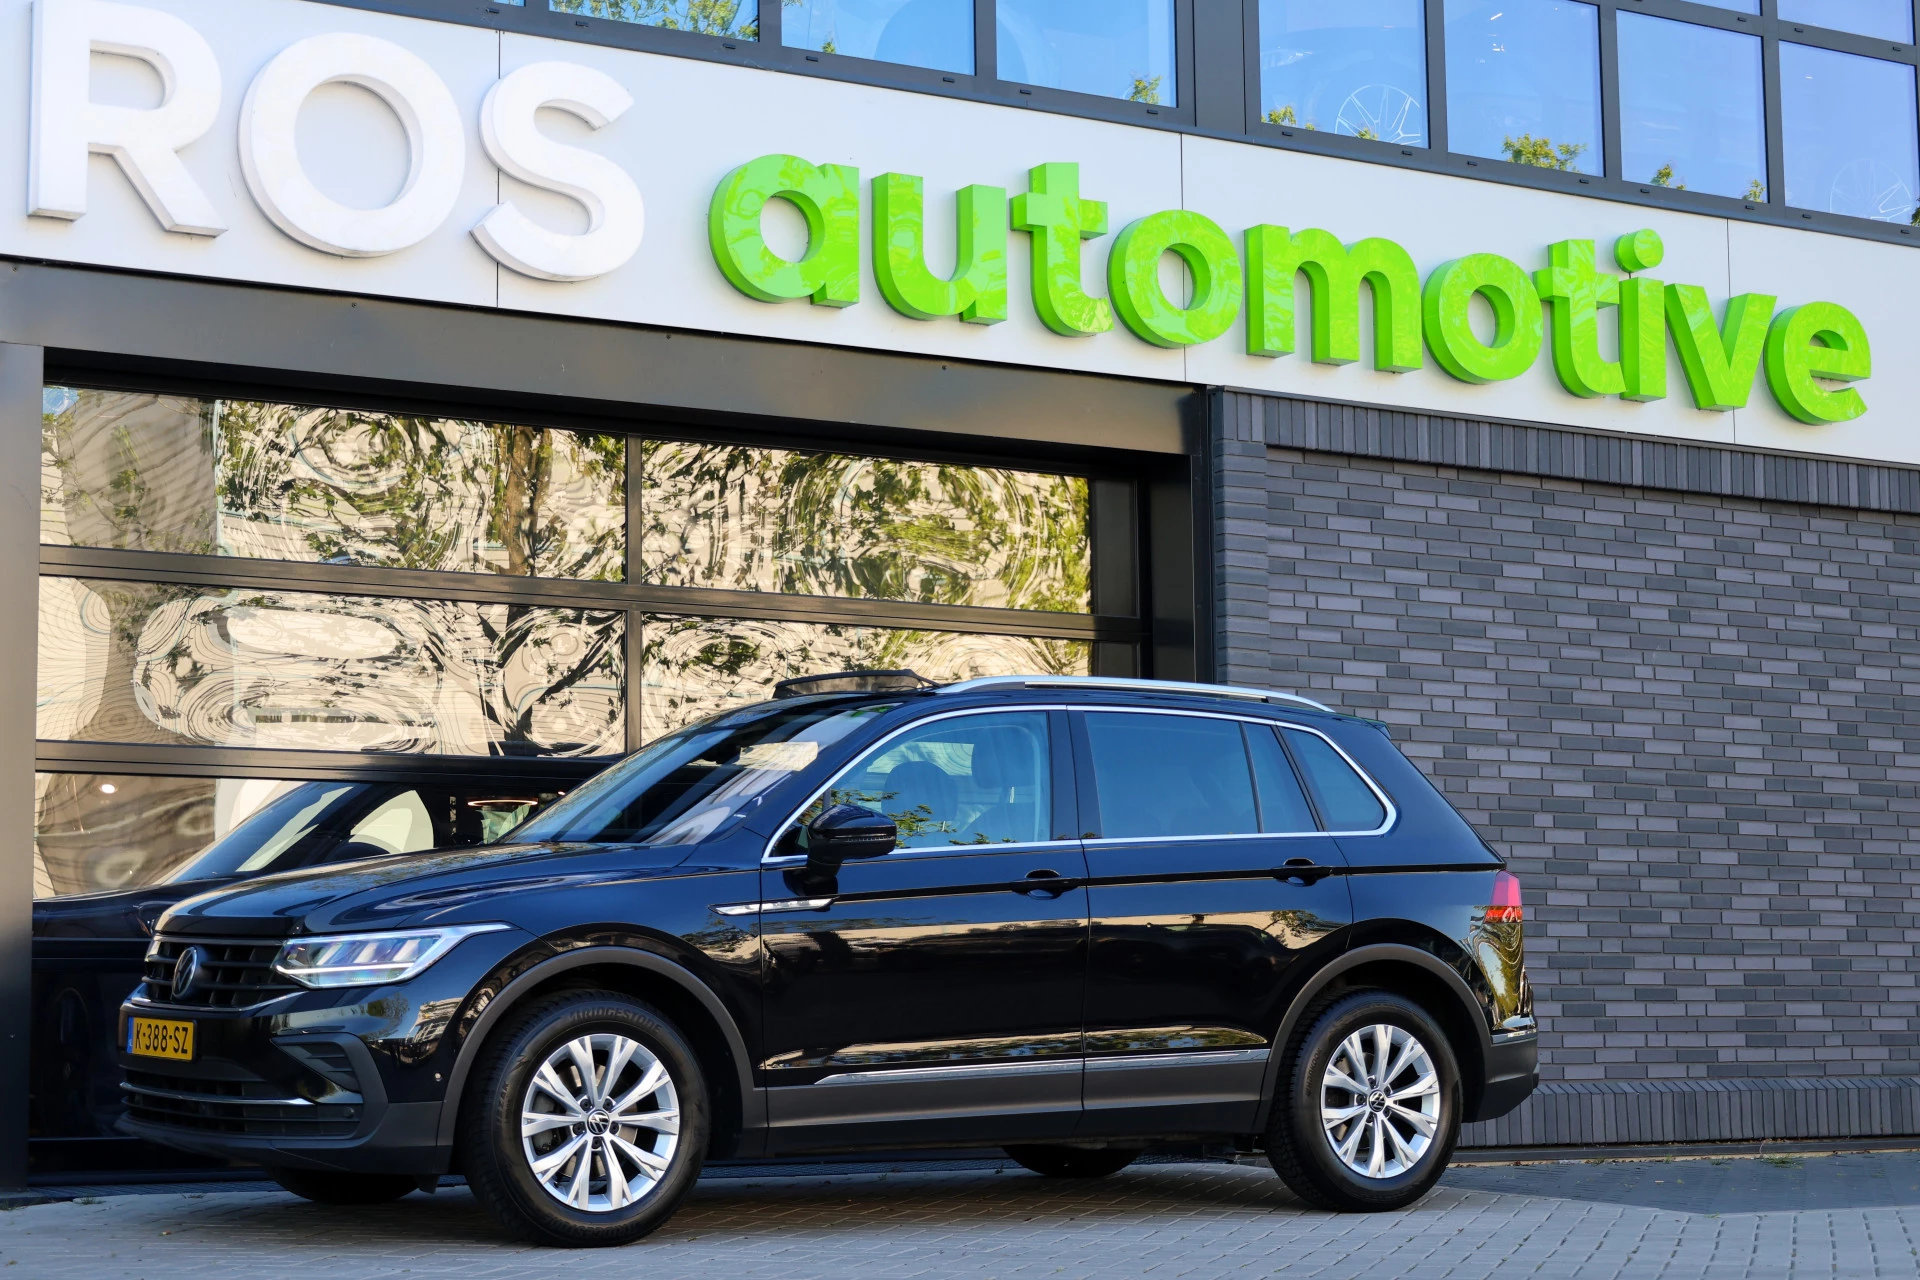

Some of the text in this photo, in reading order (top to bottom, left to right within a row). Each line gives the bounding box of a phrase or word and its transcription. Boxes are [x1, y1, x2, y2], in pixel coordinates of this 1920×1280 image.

[27, 0, 1871, 426] ROS automotive
[565, 1006, 663, 1032] BRIDGESTONE
[136, 1022, 189, 1054] K-388-SZ
